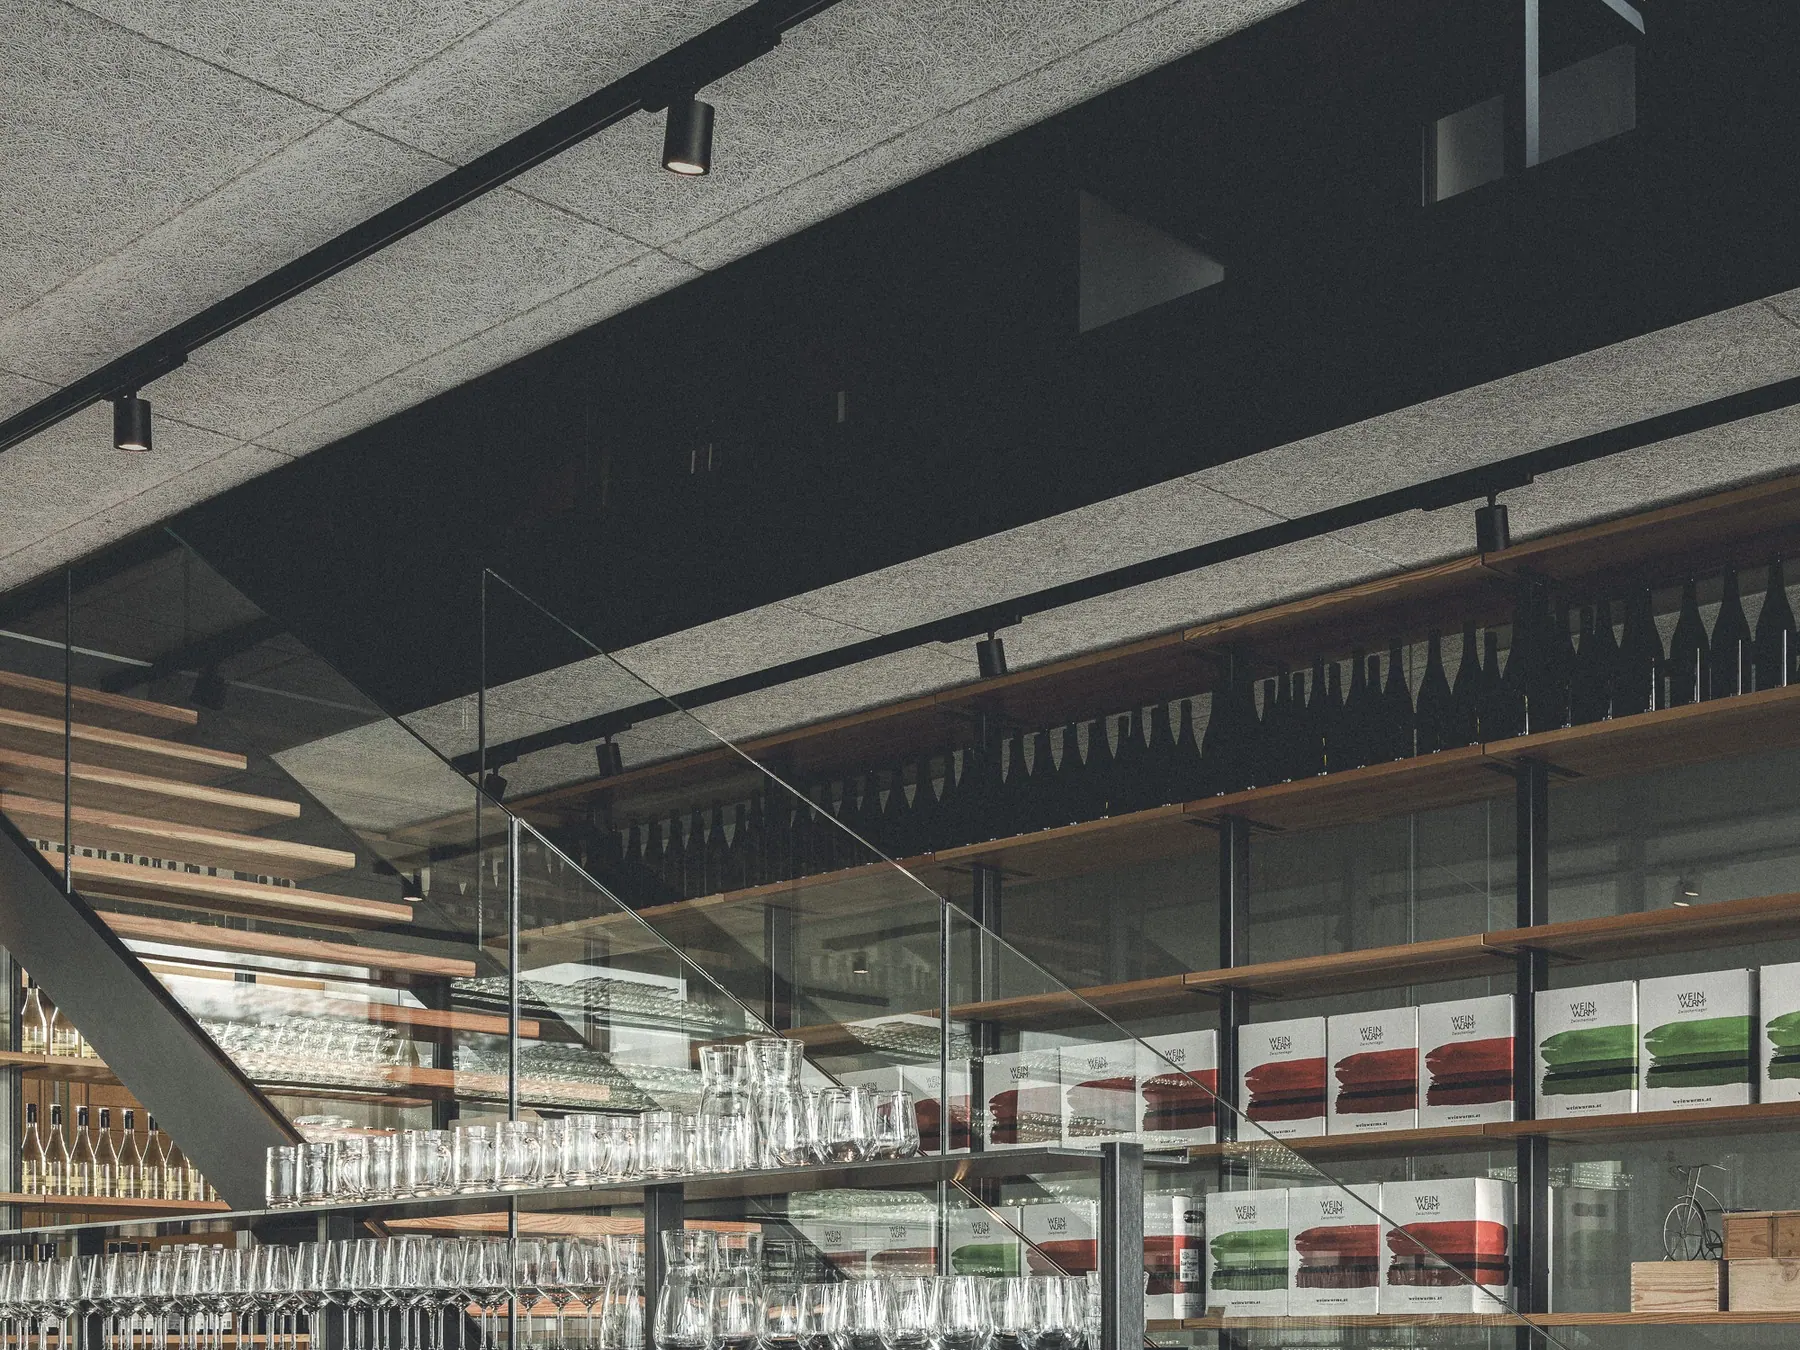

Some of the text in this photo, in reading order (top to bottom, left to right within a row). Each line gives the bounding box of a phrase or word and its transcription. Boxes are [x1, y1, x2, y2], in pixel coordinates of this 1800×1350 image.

[1677, 991, 1705, 1001] WEIN
[1570, 1001, 1595, 1011] WEIN
[1451, 1015, 1474, 1023] WEIN
[1359, 1026, 1382, 1035] WEIN
[1269, 1036, 1291, 1044] WEIN
[1164, 1048, 1185, 1057] WEIN
[1087, 1056, 1107, 1065] WEIN
[1009, 1066, 1029, 1074] WEIN
[1320, 1200, 1343, 1209] WEIN
[1414, 1196, 1439, 1204] WEIN
